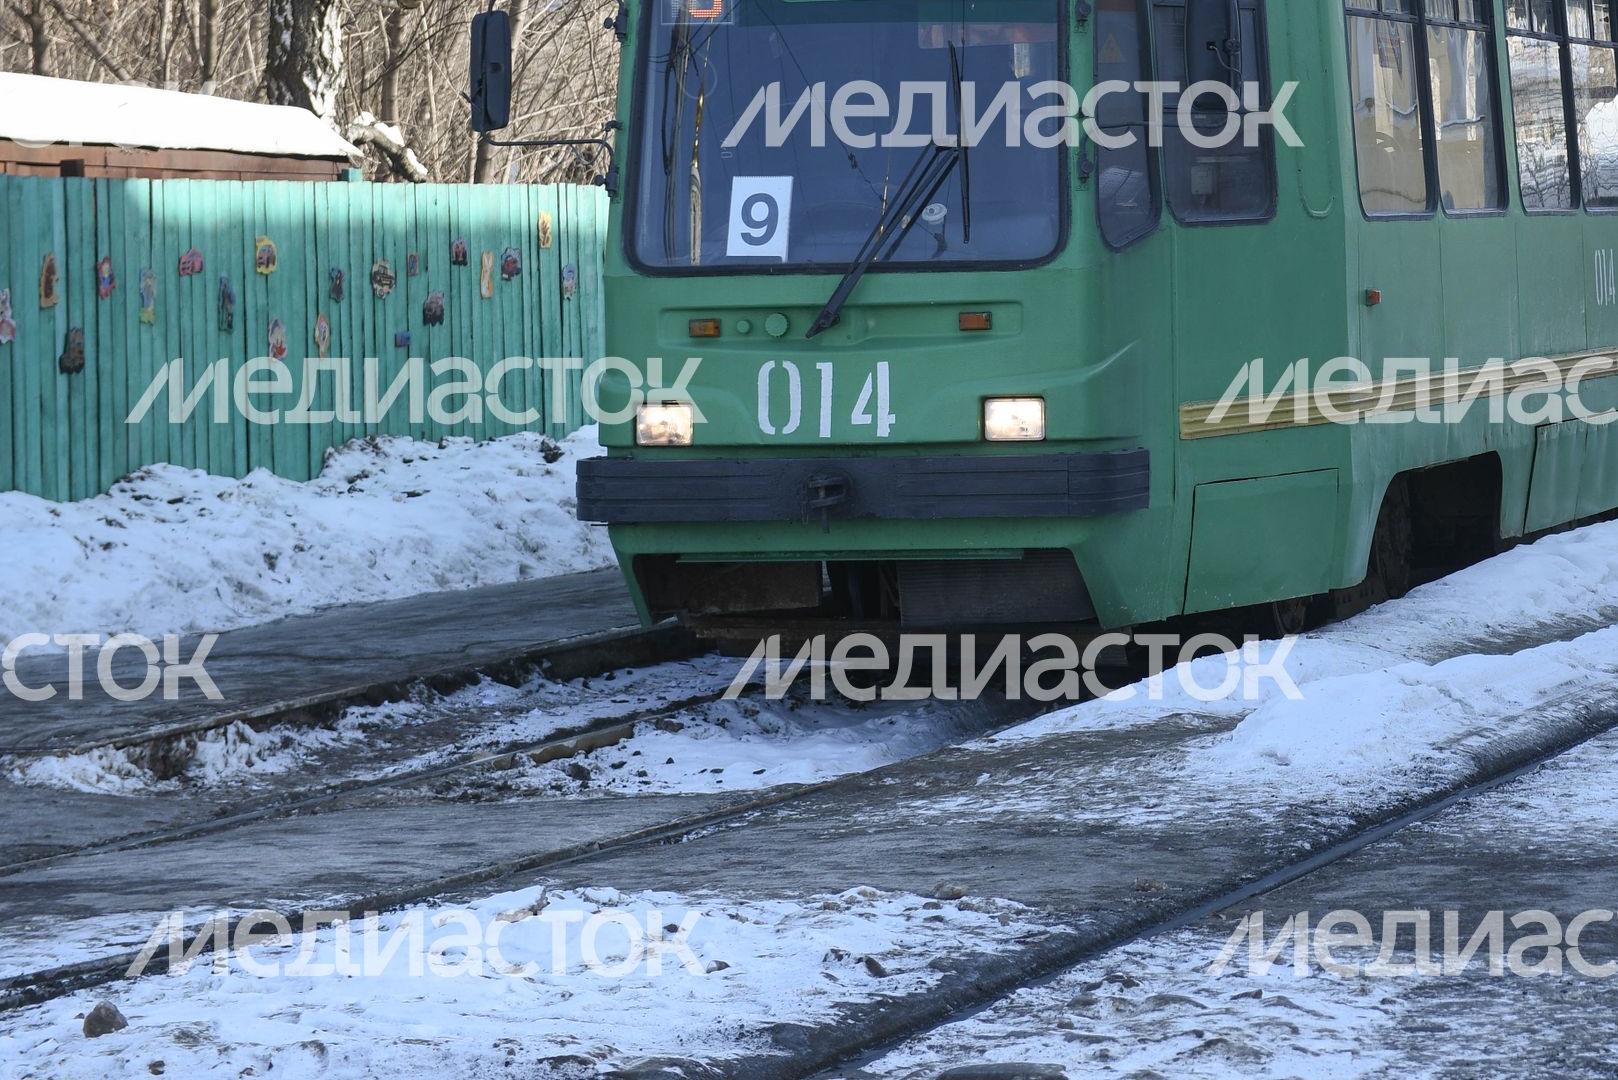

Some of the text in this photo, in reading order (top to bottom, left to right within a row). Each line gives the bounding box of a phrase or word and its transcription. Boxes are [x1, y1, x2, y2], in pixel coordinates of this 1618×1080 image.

[740, 192, 780, 246] 9
[1594, 248, 1616, 305] 014
[757, 360, 896, 438] 014
